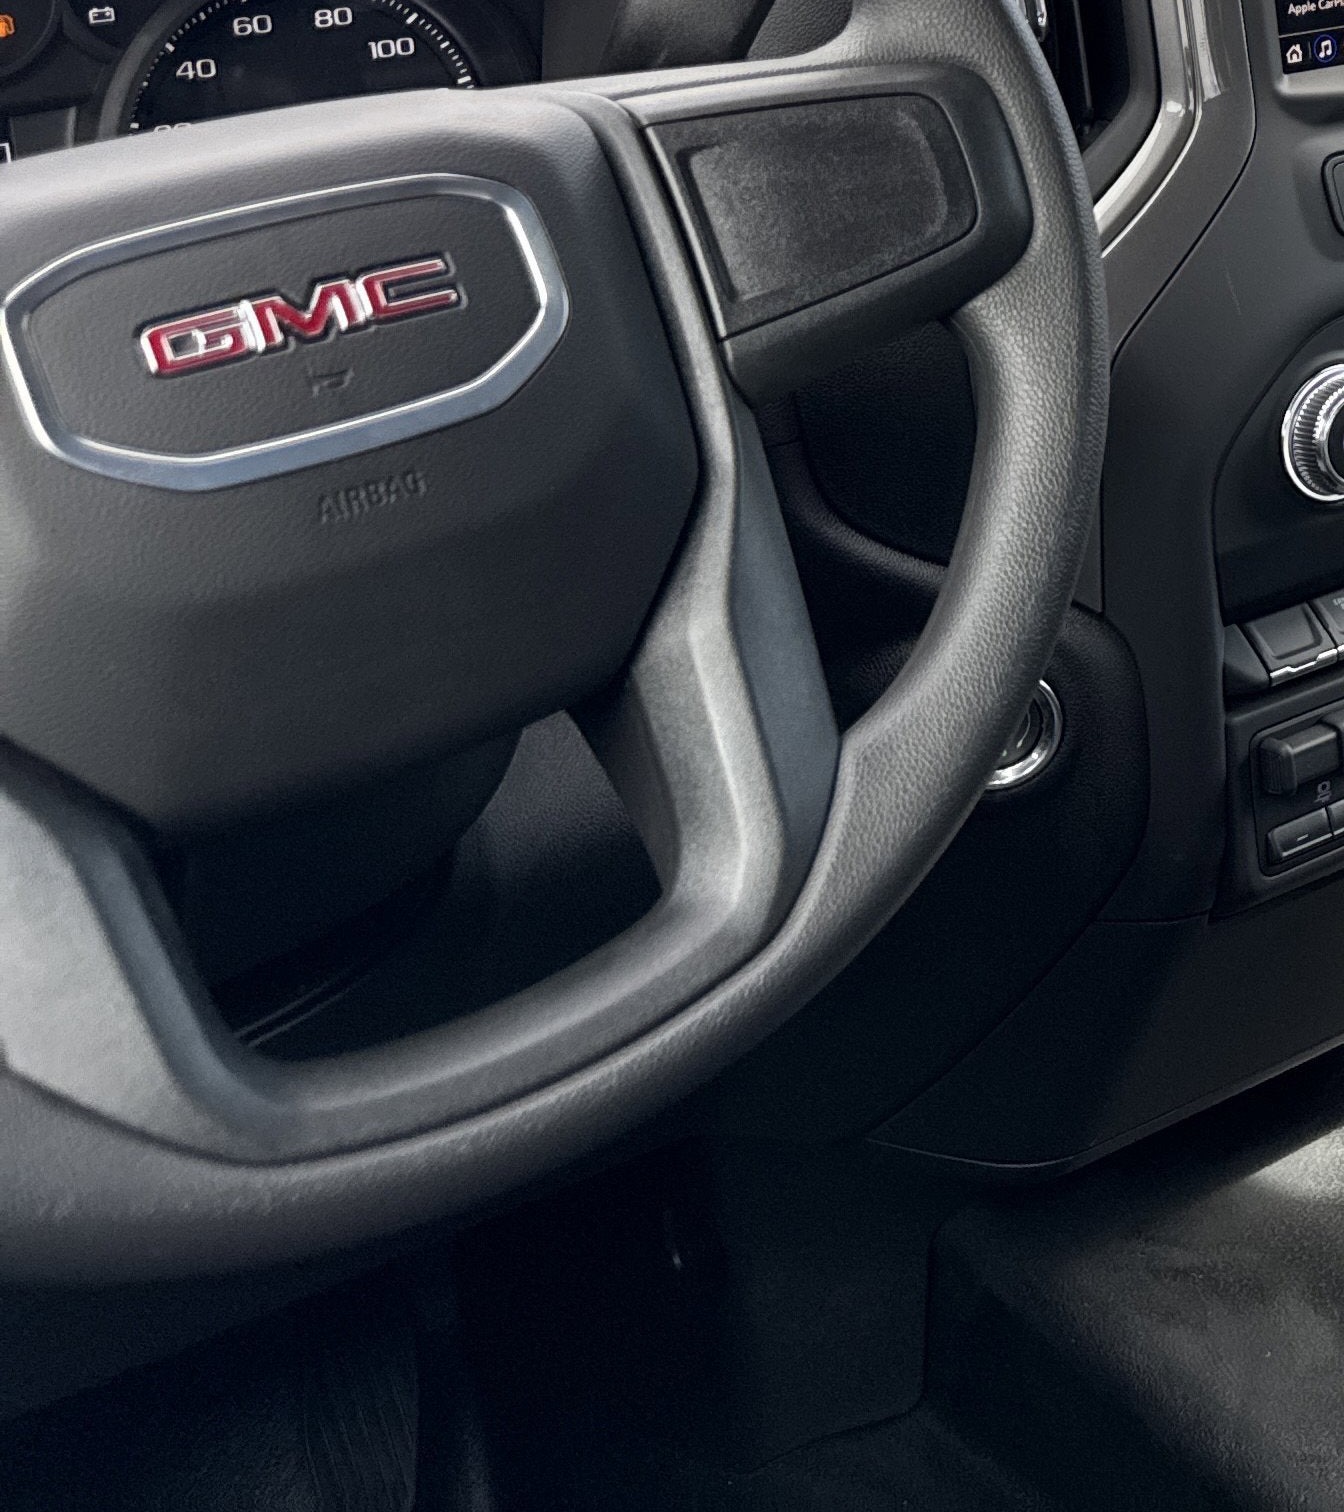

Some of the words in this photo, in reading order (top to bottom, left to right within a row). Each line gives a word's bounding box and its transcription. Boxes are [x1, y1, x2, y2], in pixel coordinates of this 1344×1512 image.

[314, 7, 353, 28] 80
[1288, 0, 1317, 17] Apple
[233, 14, 273, 36] 60
[368, 37, 415, 59] 100
[176, 58, 217, 80] 40
[141, 258, 458, 375] GMC
[318, 470, 428, 524] AIRBAG
